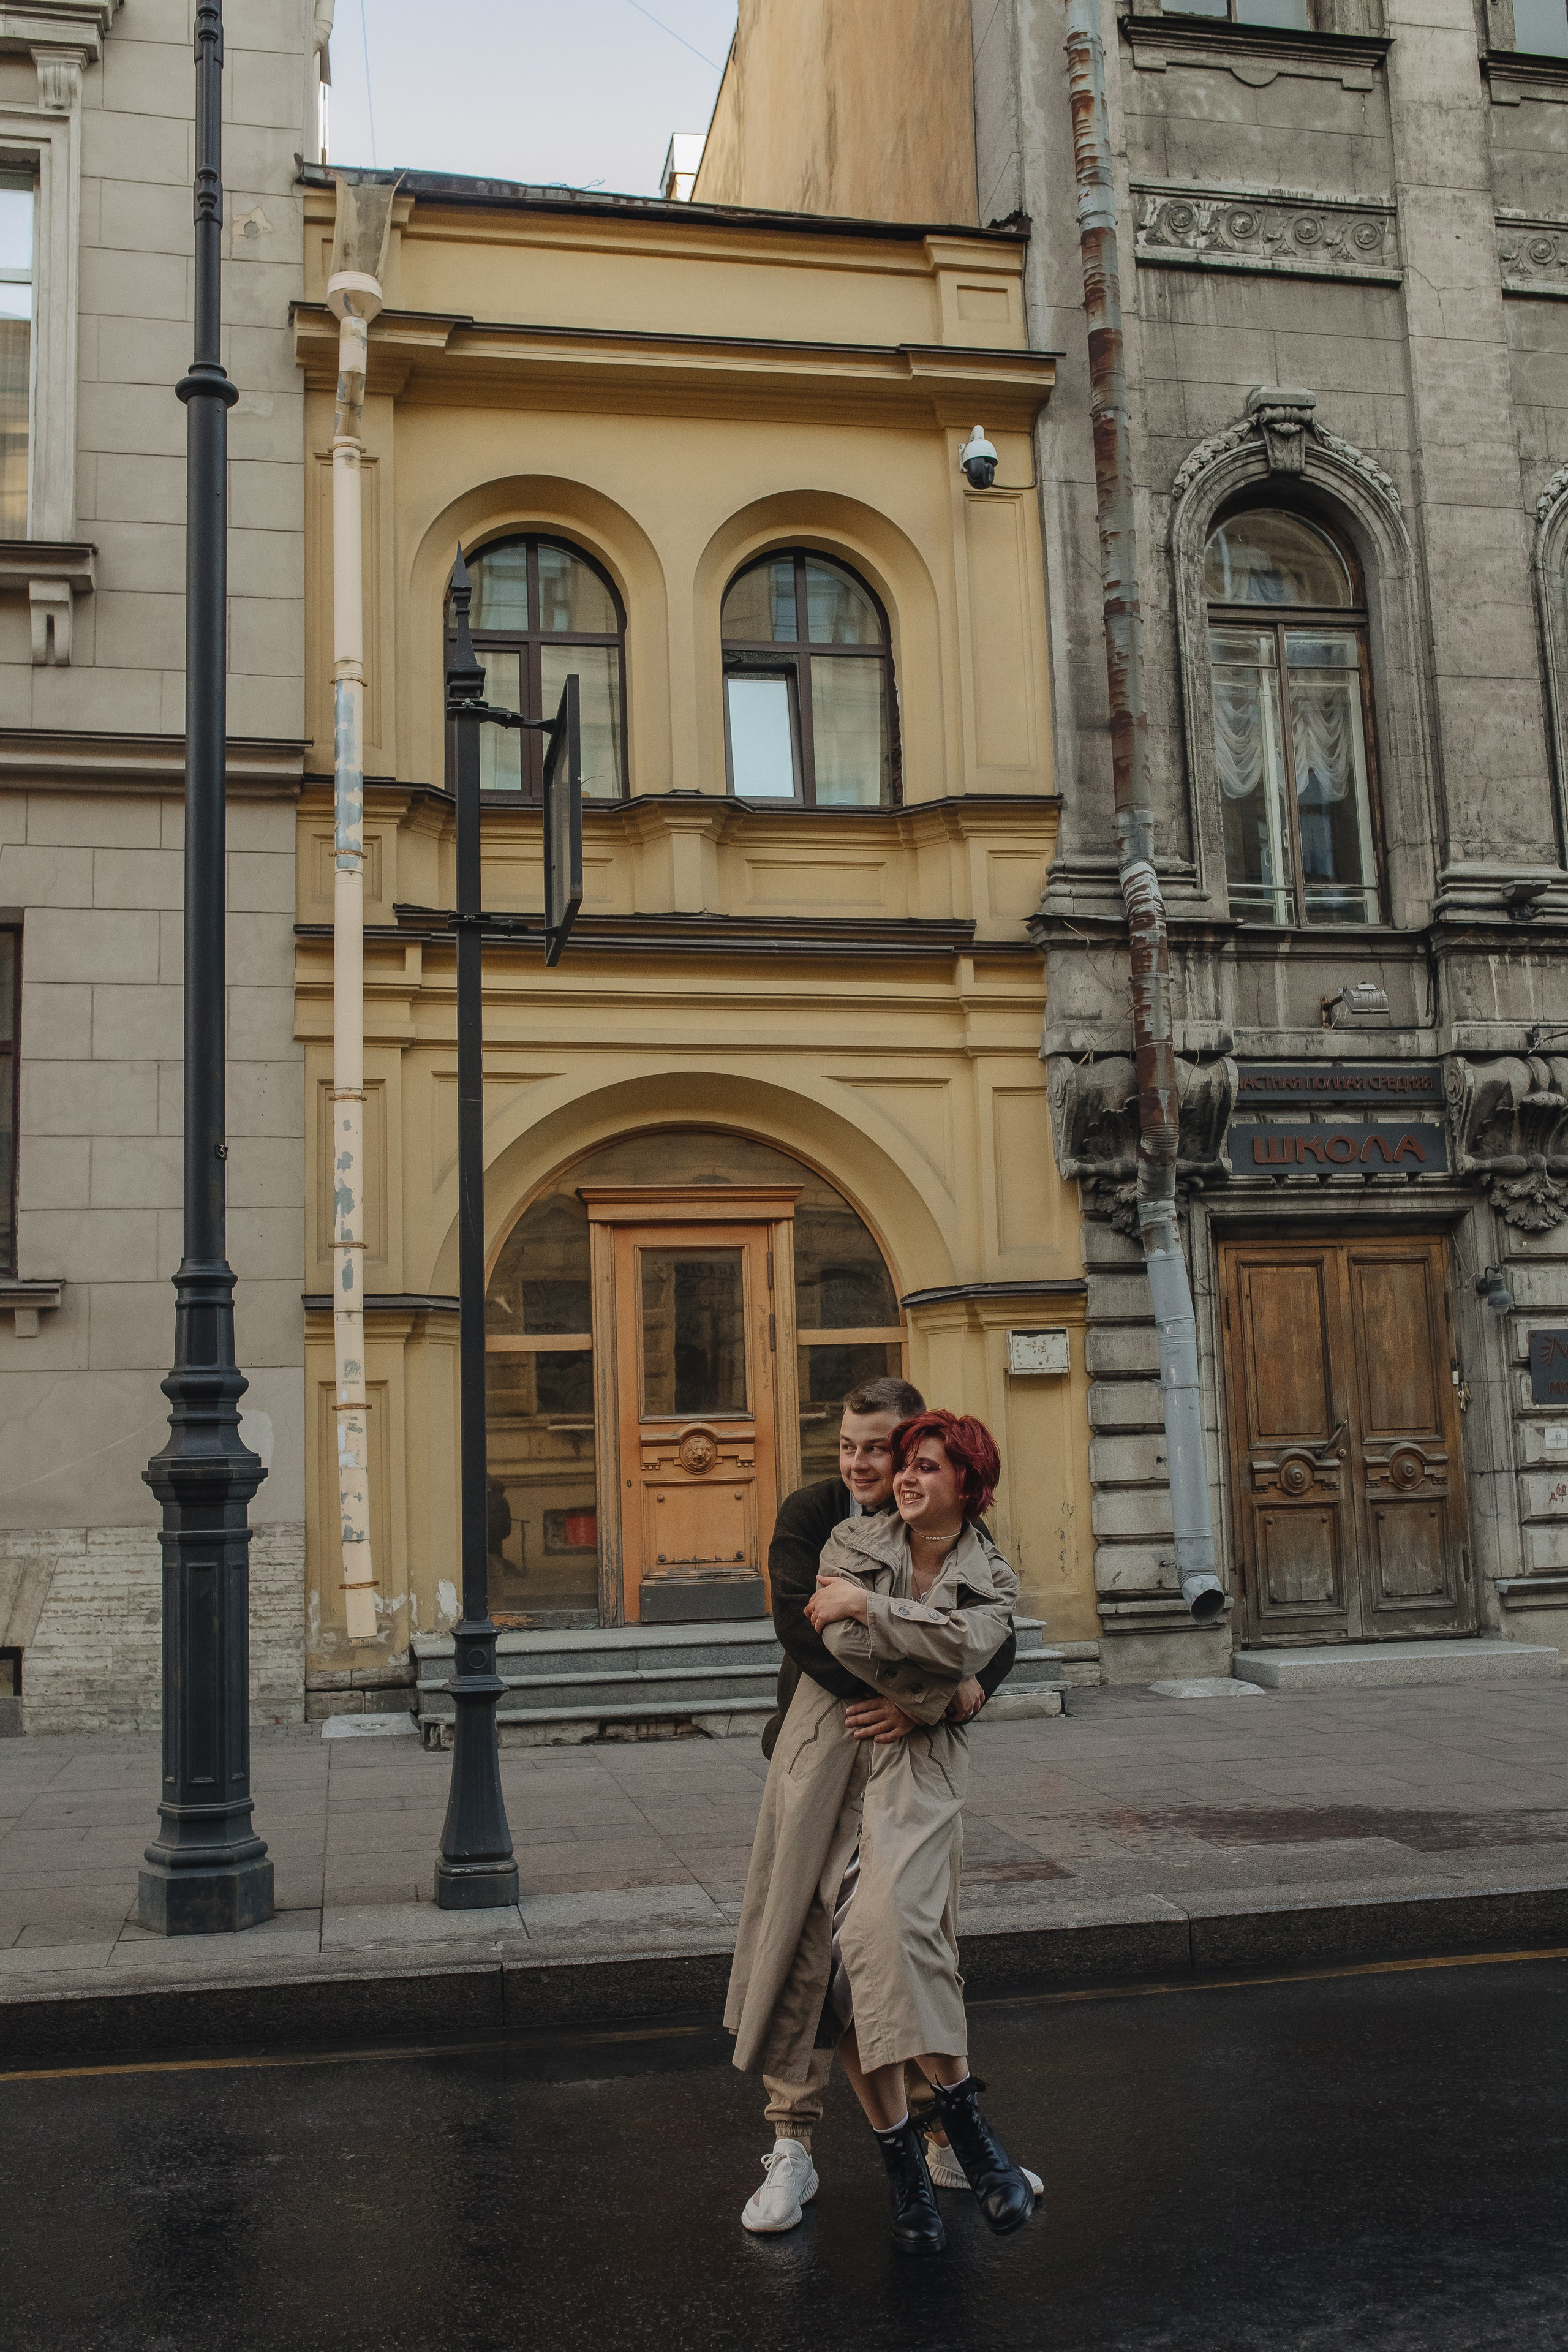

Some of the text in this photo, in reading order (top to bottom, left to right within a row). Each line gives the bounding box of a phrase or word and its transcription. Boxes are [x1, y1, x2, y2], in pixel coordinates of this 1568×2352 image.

[1306, 1076, 1366, 1090] ПОЛНАЯ
[1370, 1075, 1434, 1093] СРЕДНЯЯ
[1253, 1134, 1426, 1163] ШКОЛА
